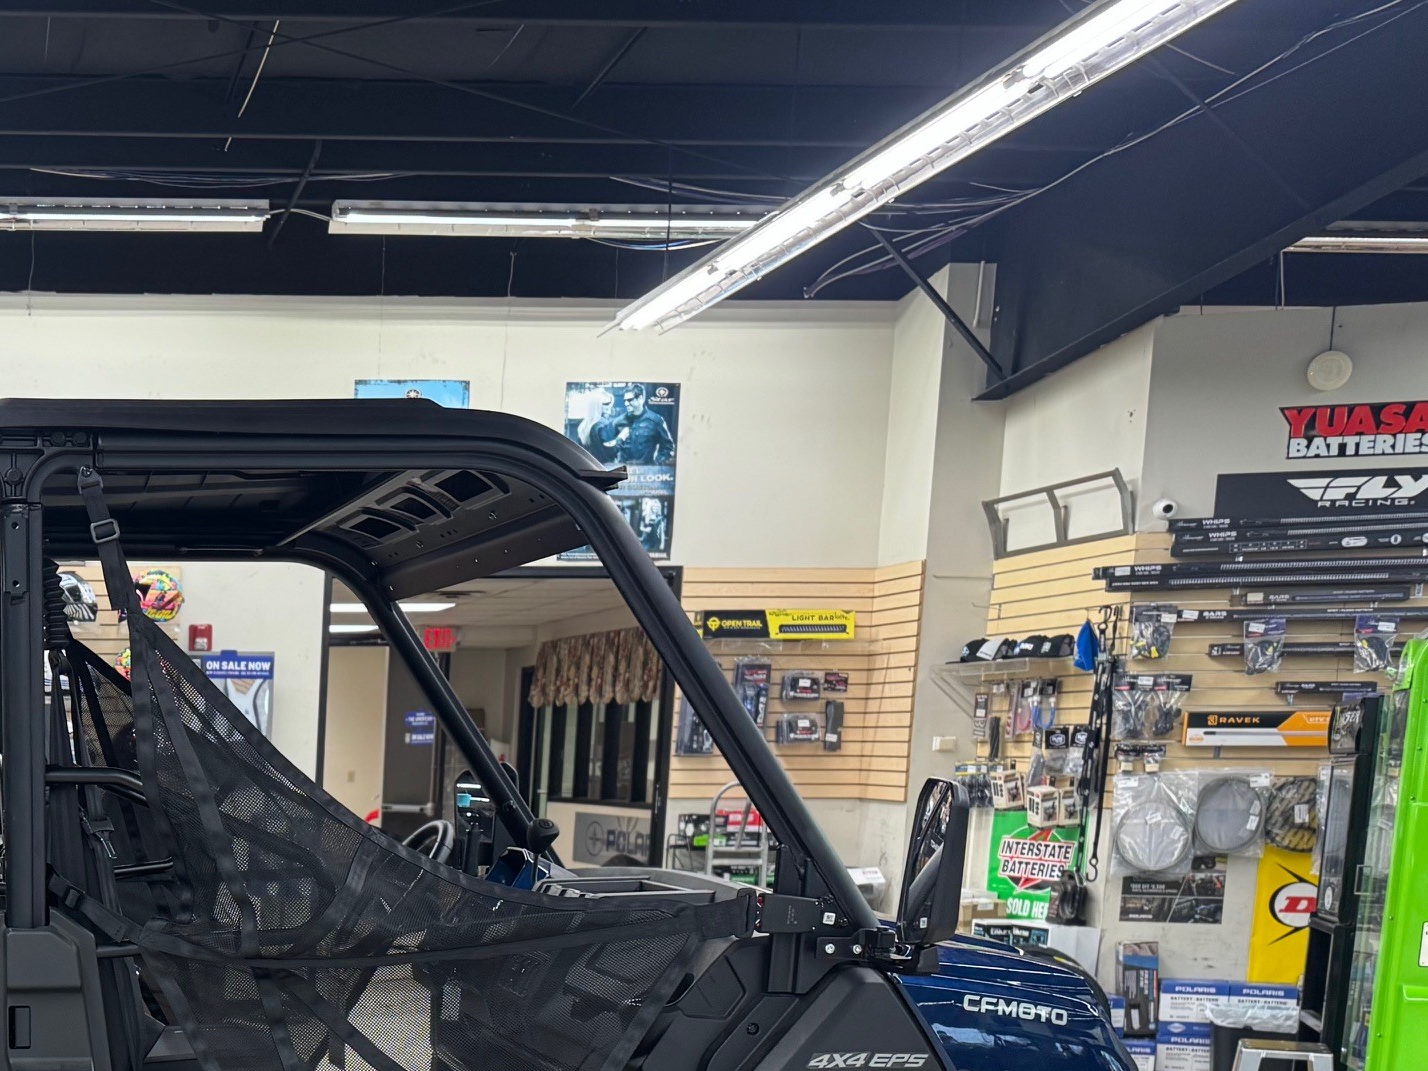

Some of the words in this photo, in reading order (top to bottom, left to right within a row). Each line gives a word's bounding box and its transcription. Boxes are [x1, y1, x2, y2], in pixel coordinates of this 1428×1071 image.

[1284, 402, 1428, 437] YUASA
[1317, 498, 1409, 508] RACING
[722, 619, 745, 627] OPEN
[205, 661, 220, 670] ON
[221, 661, 246, 670] SALE
[248, 661, 271, 671] NOW
[606, 829, 651, 858] POLA
[1001, 840, 1072, 860] INTERSTATE
[1001, 859, 1065, 878] BATTERIES
[1006, 897, 1030, 916] SOLD
[1032, 901, 1049, 919] HE
[1175, 985, 1217, 994] POLARIS
[1242, 988, 1285, 996] POLARIS
[963, 994, 1068, 1026] CFMOTO
[808, 1053, 868, 1068] 4X4
[869, 1053, 929, 1068] EPS
